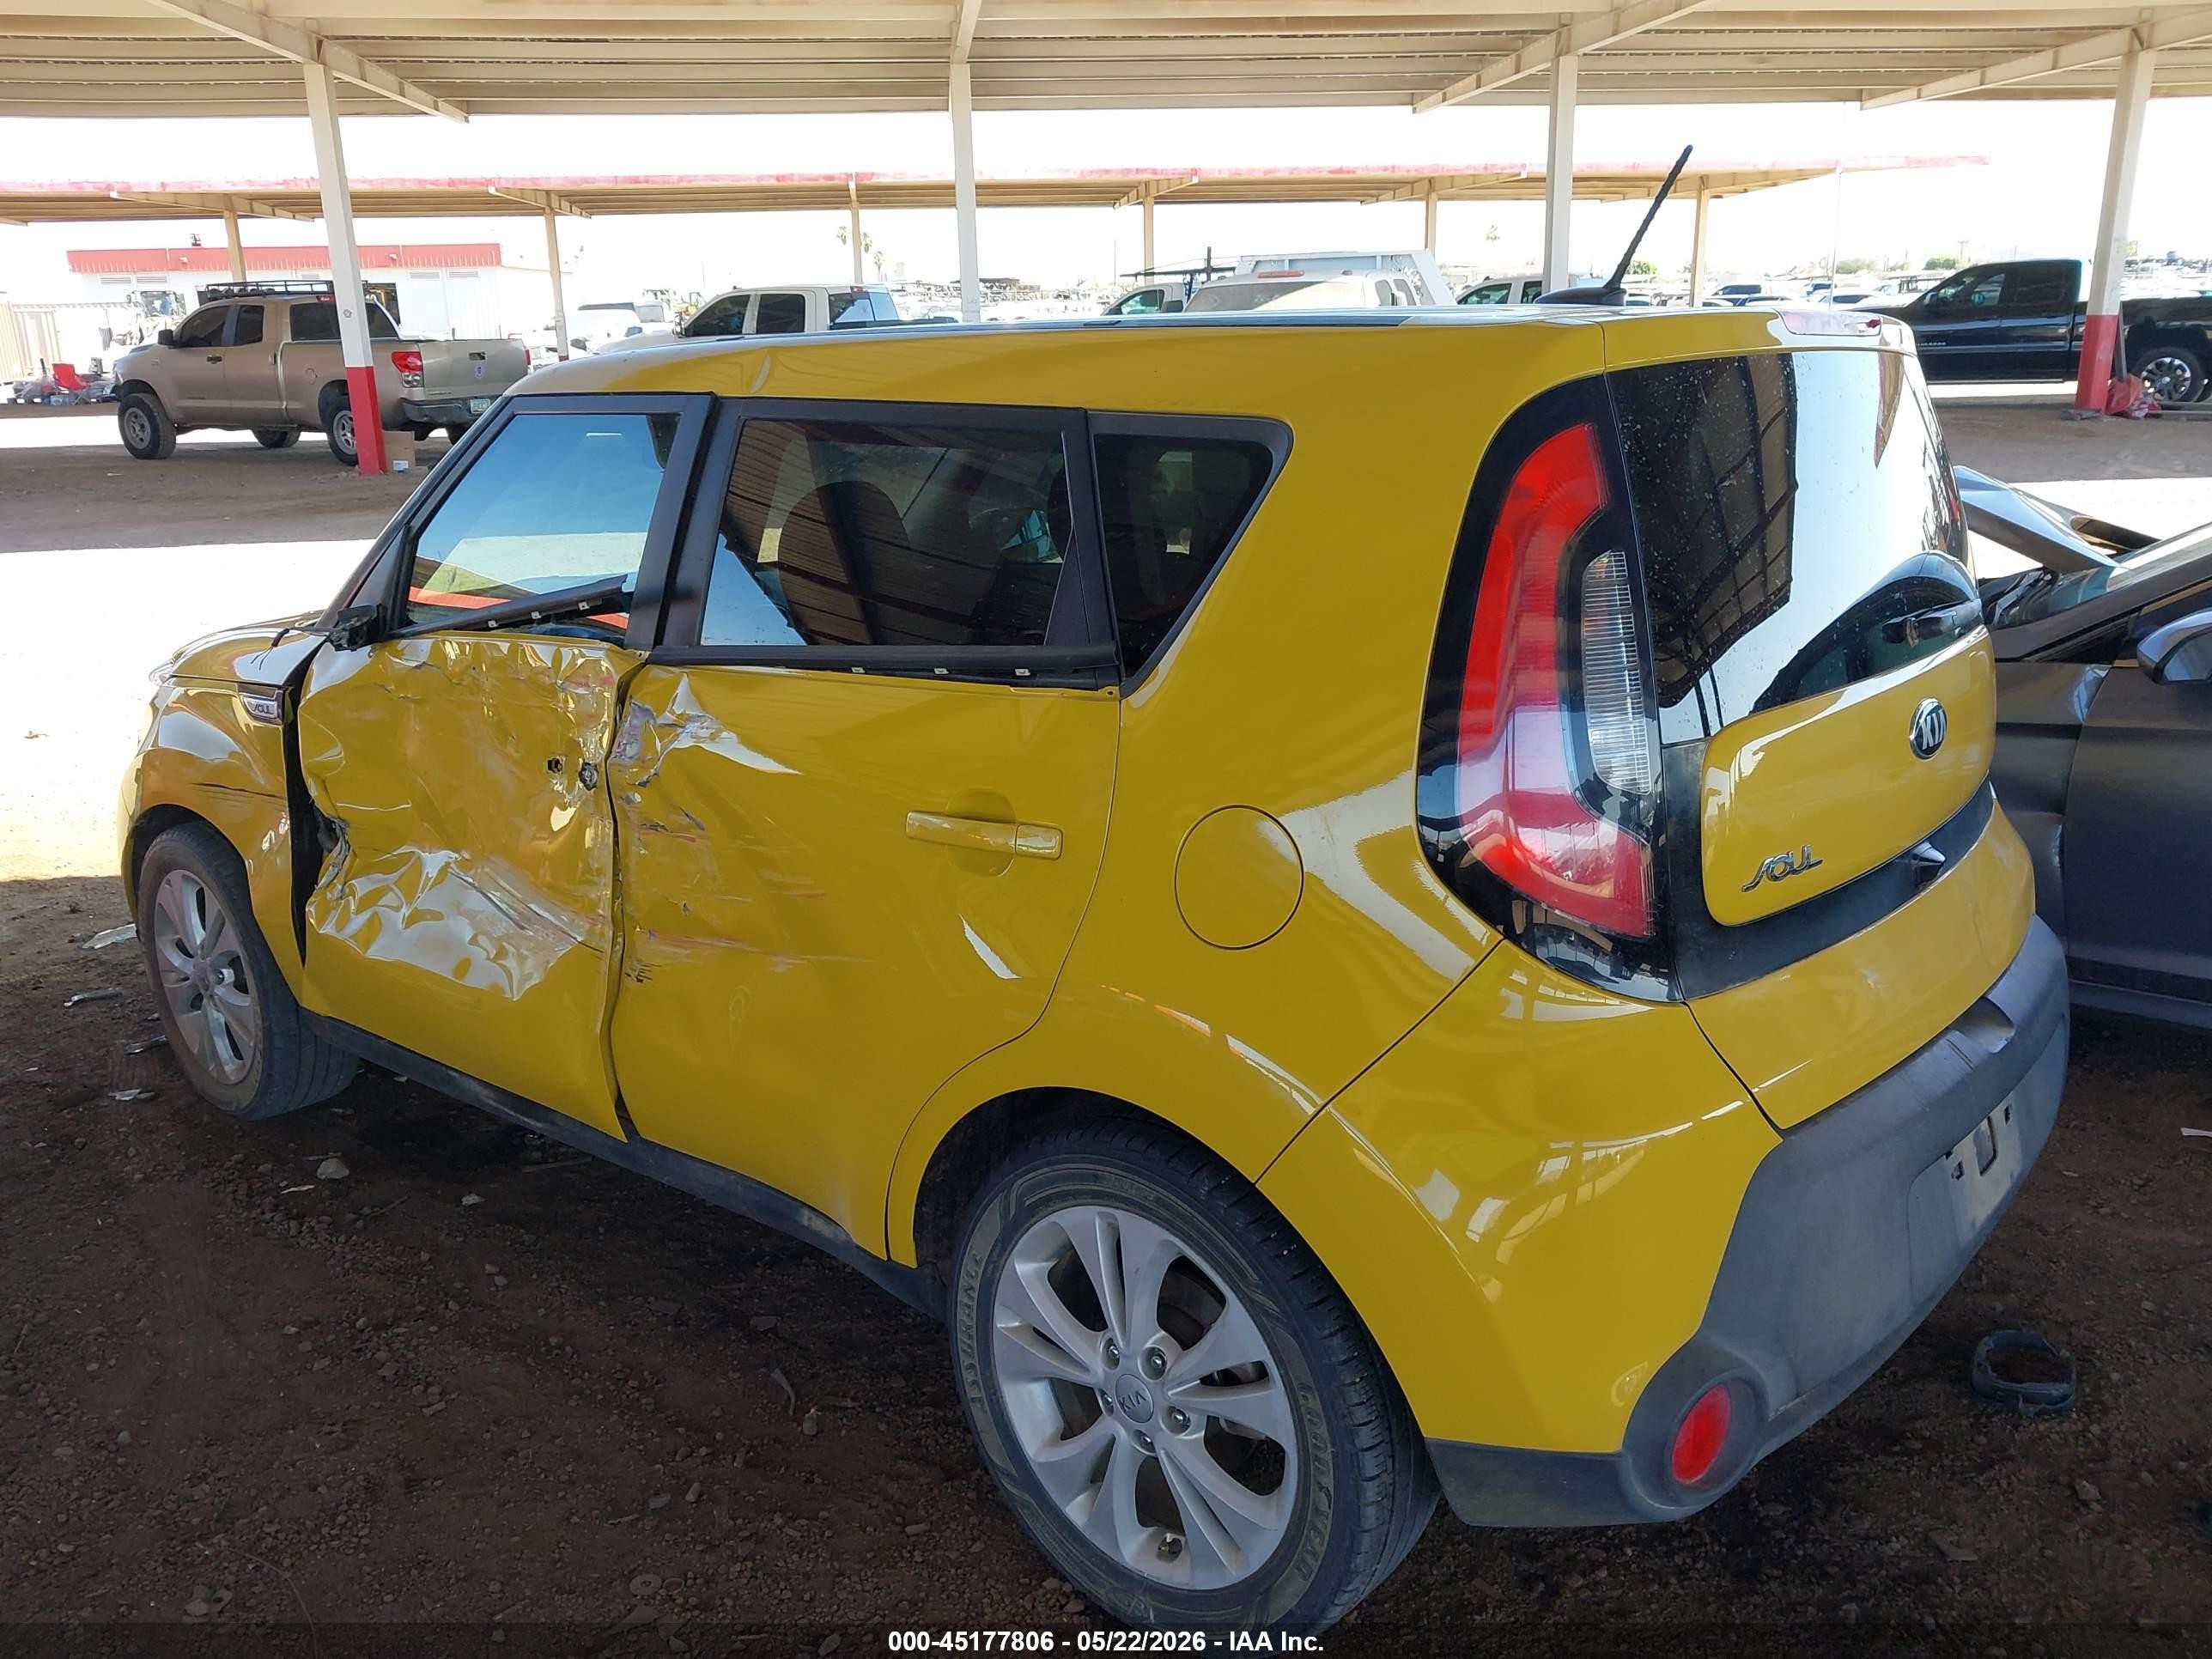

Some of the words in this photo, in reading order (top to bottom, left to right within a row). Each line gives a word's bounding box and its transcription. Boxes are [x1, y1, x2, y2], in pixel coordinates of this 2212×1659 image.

[1918, 706, 1945, 750] KIA
[1741, 844, 1824, 893] SOUL
[1118, 1389, 1147, 1412] KIA
[1297, 1382, 1333, 1582] GOODYEAR
